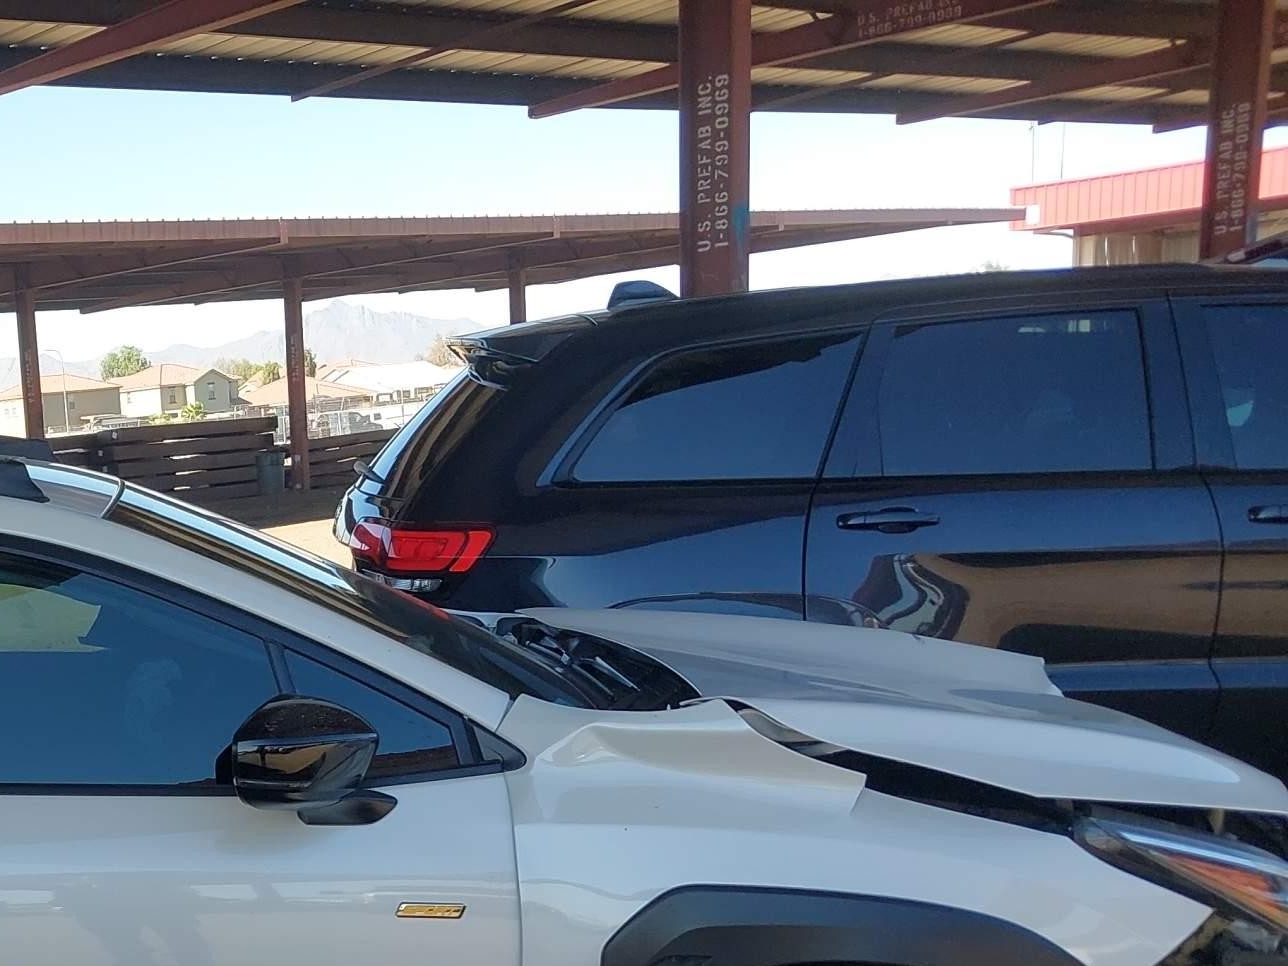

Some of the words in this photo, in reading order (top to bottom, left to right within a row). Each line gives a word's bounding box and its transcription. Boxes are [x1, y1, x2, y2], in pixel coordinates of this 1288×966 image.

[697, 75, 713, 115] INC.
[1222, 102, 1237, 135] INC.
[696, 126, 712, 204] PREFAB
[714, 73, 729, 248] 1-866-799-0969
[1217, 140, 1233, 200] PREFAB
[696, 213, 712, 253] U.S.
[1213, 204, 1228, 236] U.S.
